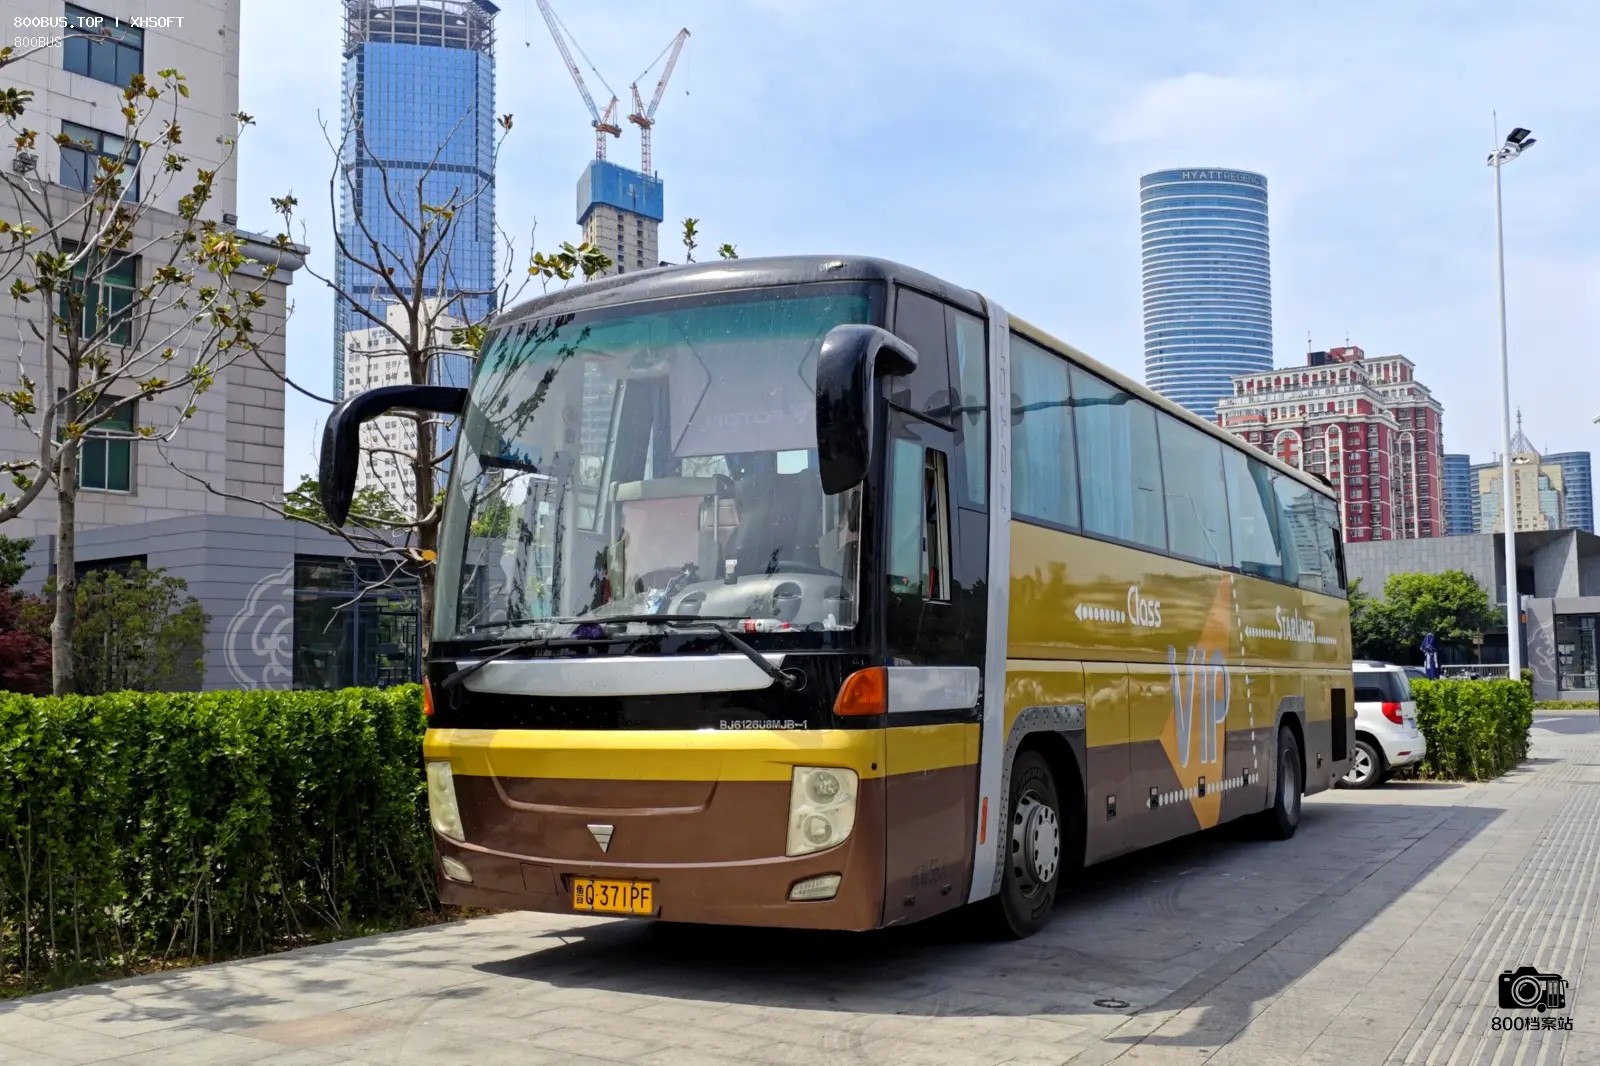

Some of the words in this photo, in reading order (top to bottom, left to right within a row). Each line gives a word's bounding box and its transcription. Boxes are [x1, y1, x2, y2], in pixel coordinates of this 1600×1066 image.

[1182, 171, 1222, 180] HYATT
[1223, 172, 1266, 186] REGENC
[1127, 585, 1162, 628] Class
[1167, 644, 1231, 768] VIP
[720, 719, 807, 730] BJ6126U8MJB-1
